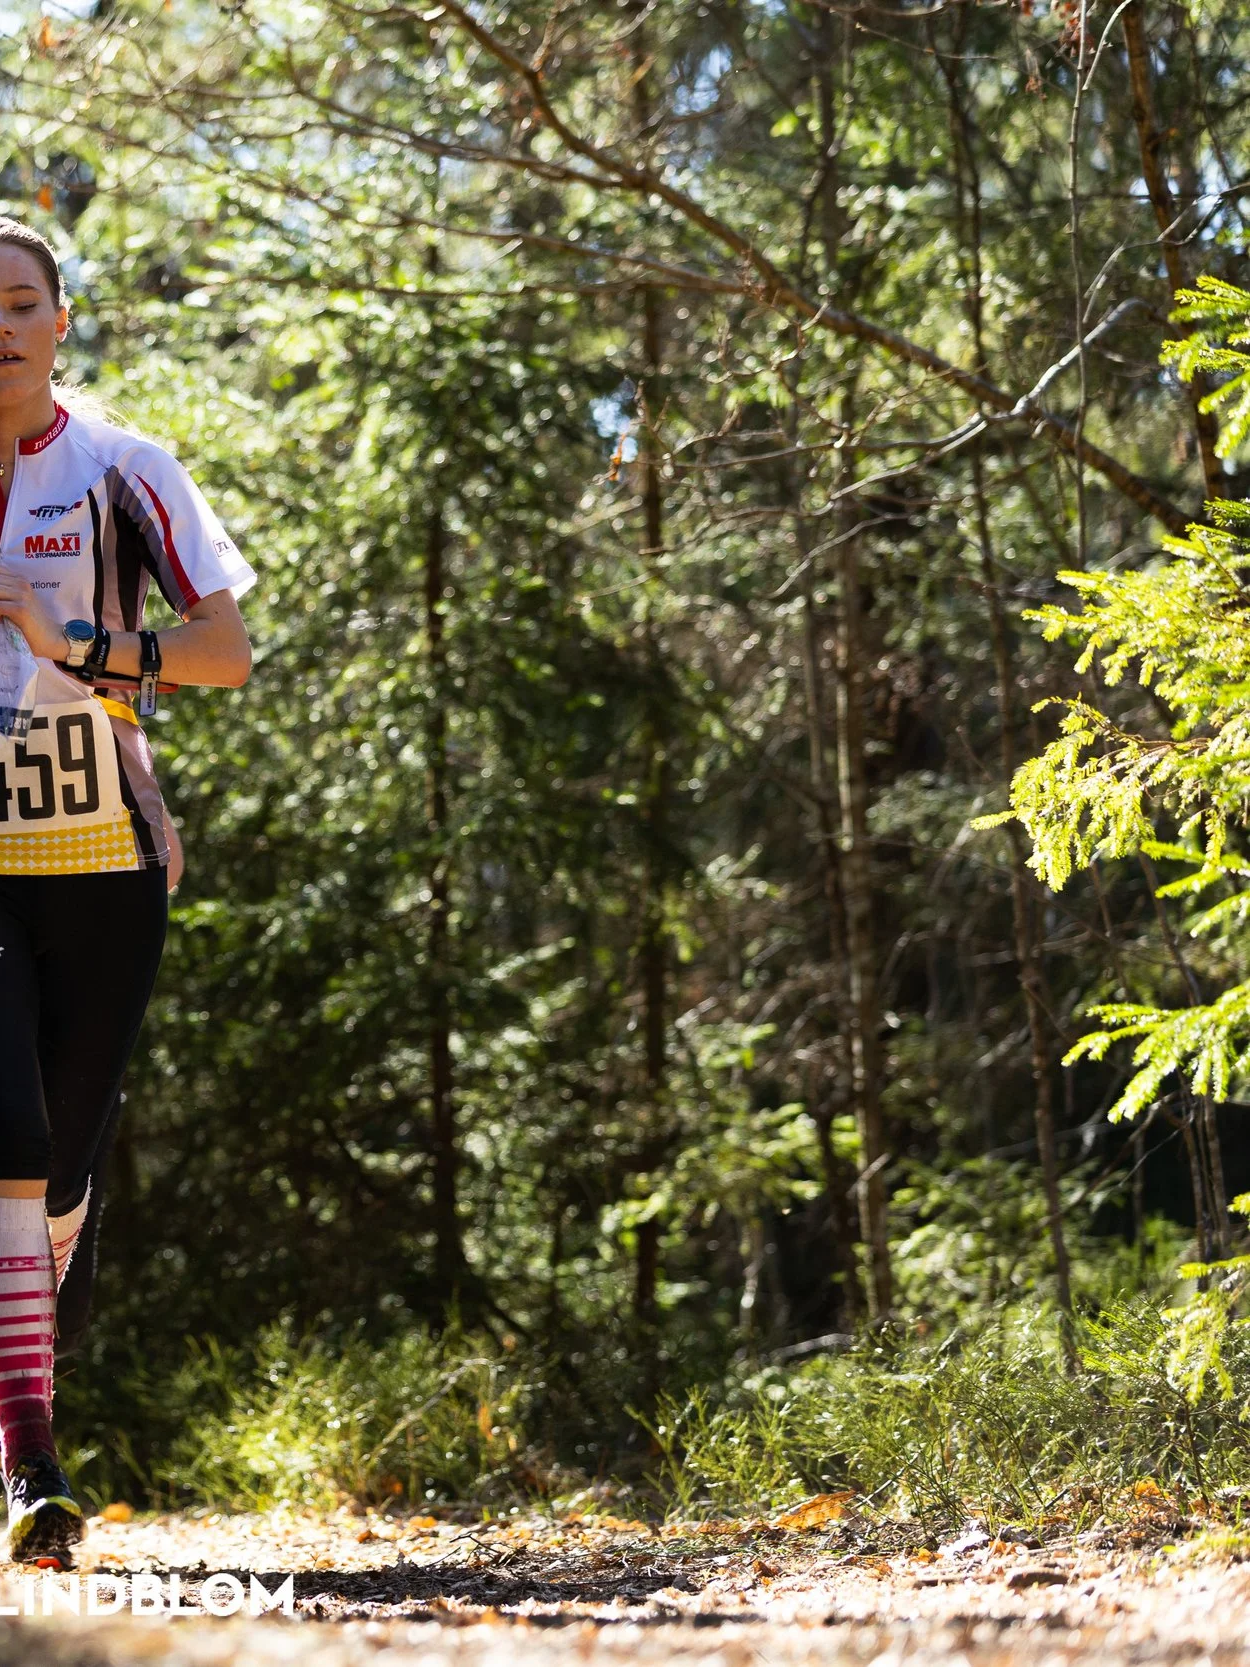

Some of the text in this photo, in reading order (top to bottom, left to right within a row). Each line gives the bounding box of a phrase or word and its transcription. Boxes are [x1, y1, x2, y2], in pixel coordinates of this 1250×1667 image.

[24, 535, 80, 553] MAXI
[35, 551, 80, 559] STORMARKNAD
[30, 581, 61, 589] ationer
